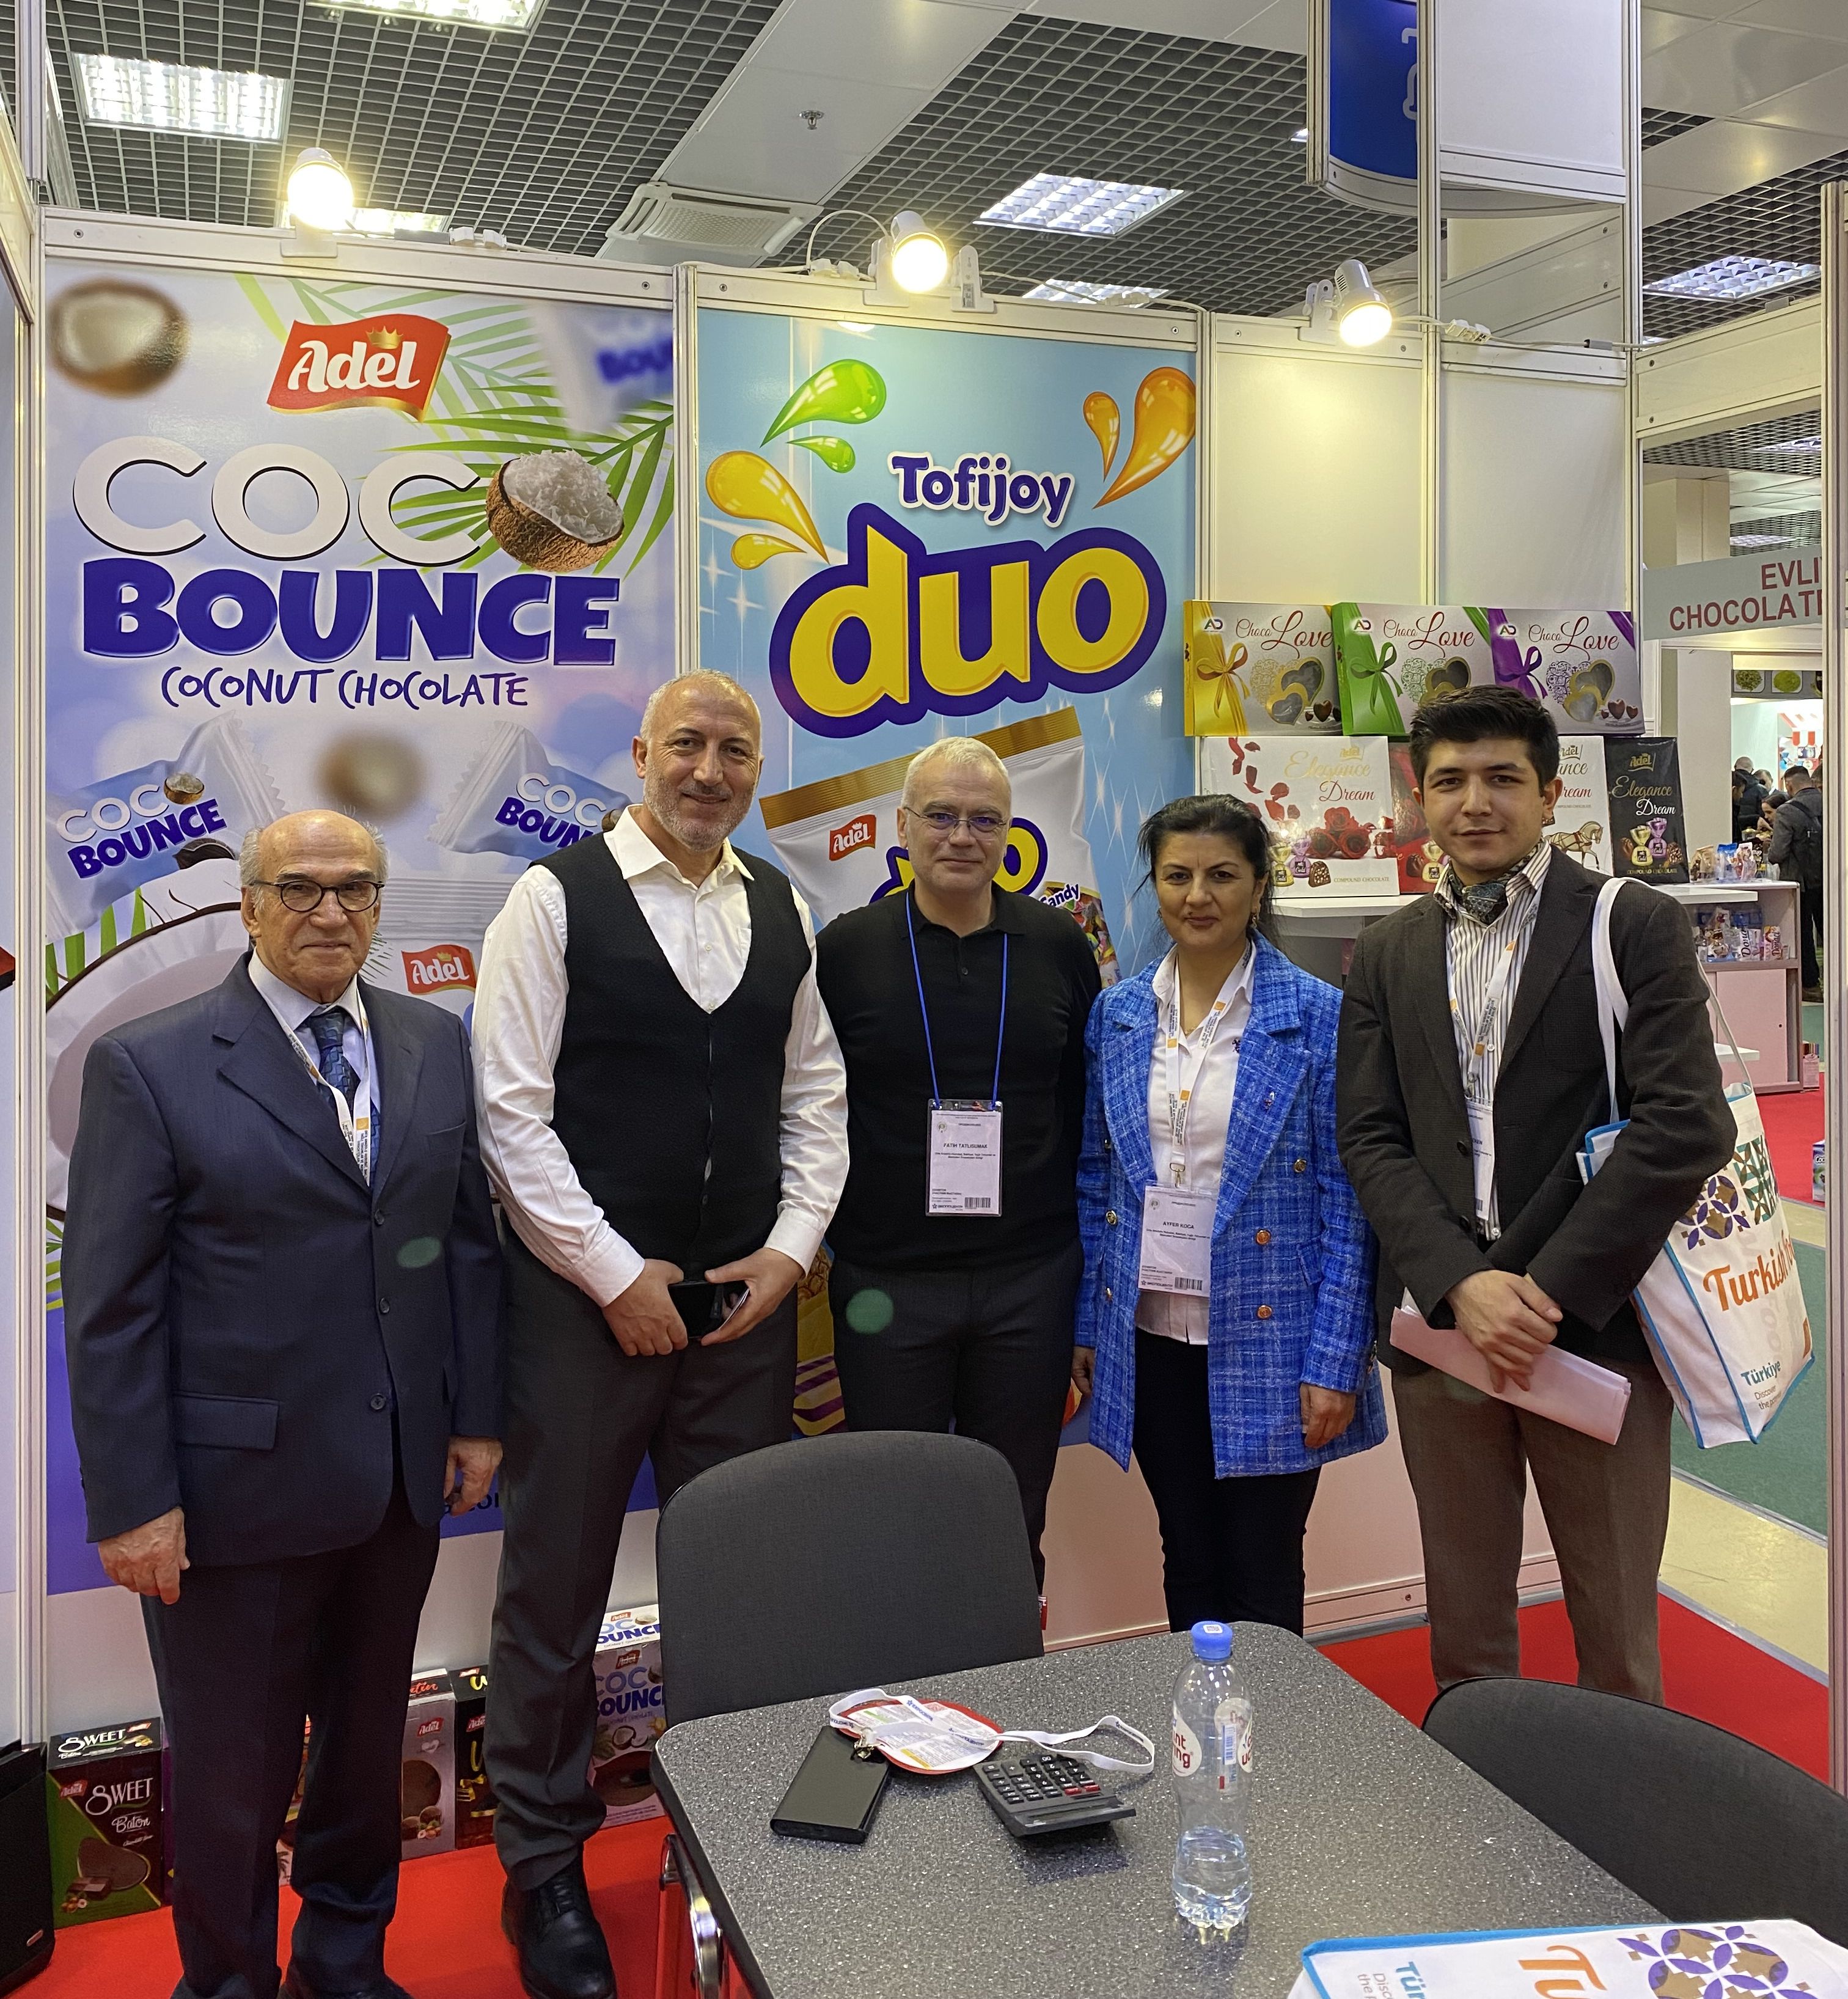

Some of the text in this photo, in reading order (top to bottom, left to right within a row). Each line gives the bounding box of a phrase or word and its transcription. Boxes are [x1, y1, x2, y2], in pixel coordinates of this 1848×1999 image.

[287, 340, 420, 392] Adel
[891, 456, 1071, 524] Tofijoy
[1761, 557, 1822, 590] EVLI
[82, 557, 620, 666] BOUNCE
[788, 524, 1150, 718] duo
[1235, 610, 1333, 659] Choco Love
[1383, 611, 1475, 658] Choco Love
[1528, 616, 1619, 661] Choco Love
[161, 667, 529, 710] COCONUT CHOCOLATE
[1284, 750, 1371, 784] Elegance
[1558, 763, 1588, 775] ance
[1630, 754, 1652, 768] Adel
[1318, 780, 1375, 802] Dream
[1563, 787, 1591, 798] ream
[1612, 775, 1672, 799] Elegance
[495, 796, 594, 848] BOUN
[1636, 798, 1676, 816] Dream
[67, 798, 227, 879] BOUNCE
[833, 824, 871, 853] Adel
[410, 956, 470, 985] Adel
[1703, 1241, 1789, 1312] Turkish
[1740, 1360, 1781, 1386] Türkiye
[597, 1624, 661, 1645] OUNC
[601, 1619, 636, 1634] OC
[598, 1685, 664, 1717] OUNC
[419, 1720, 439, 1735] Adel
[468, 1715, 486, 1729] Ade
[57, 1729, 126, 1753] SWEET
[86, 1777, 153, 1816] SWEET
